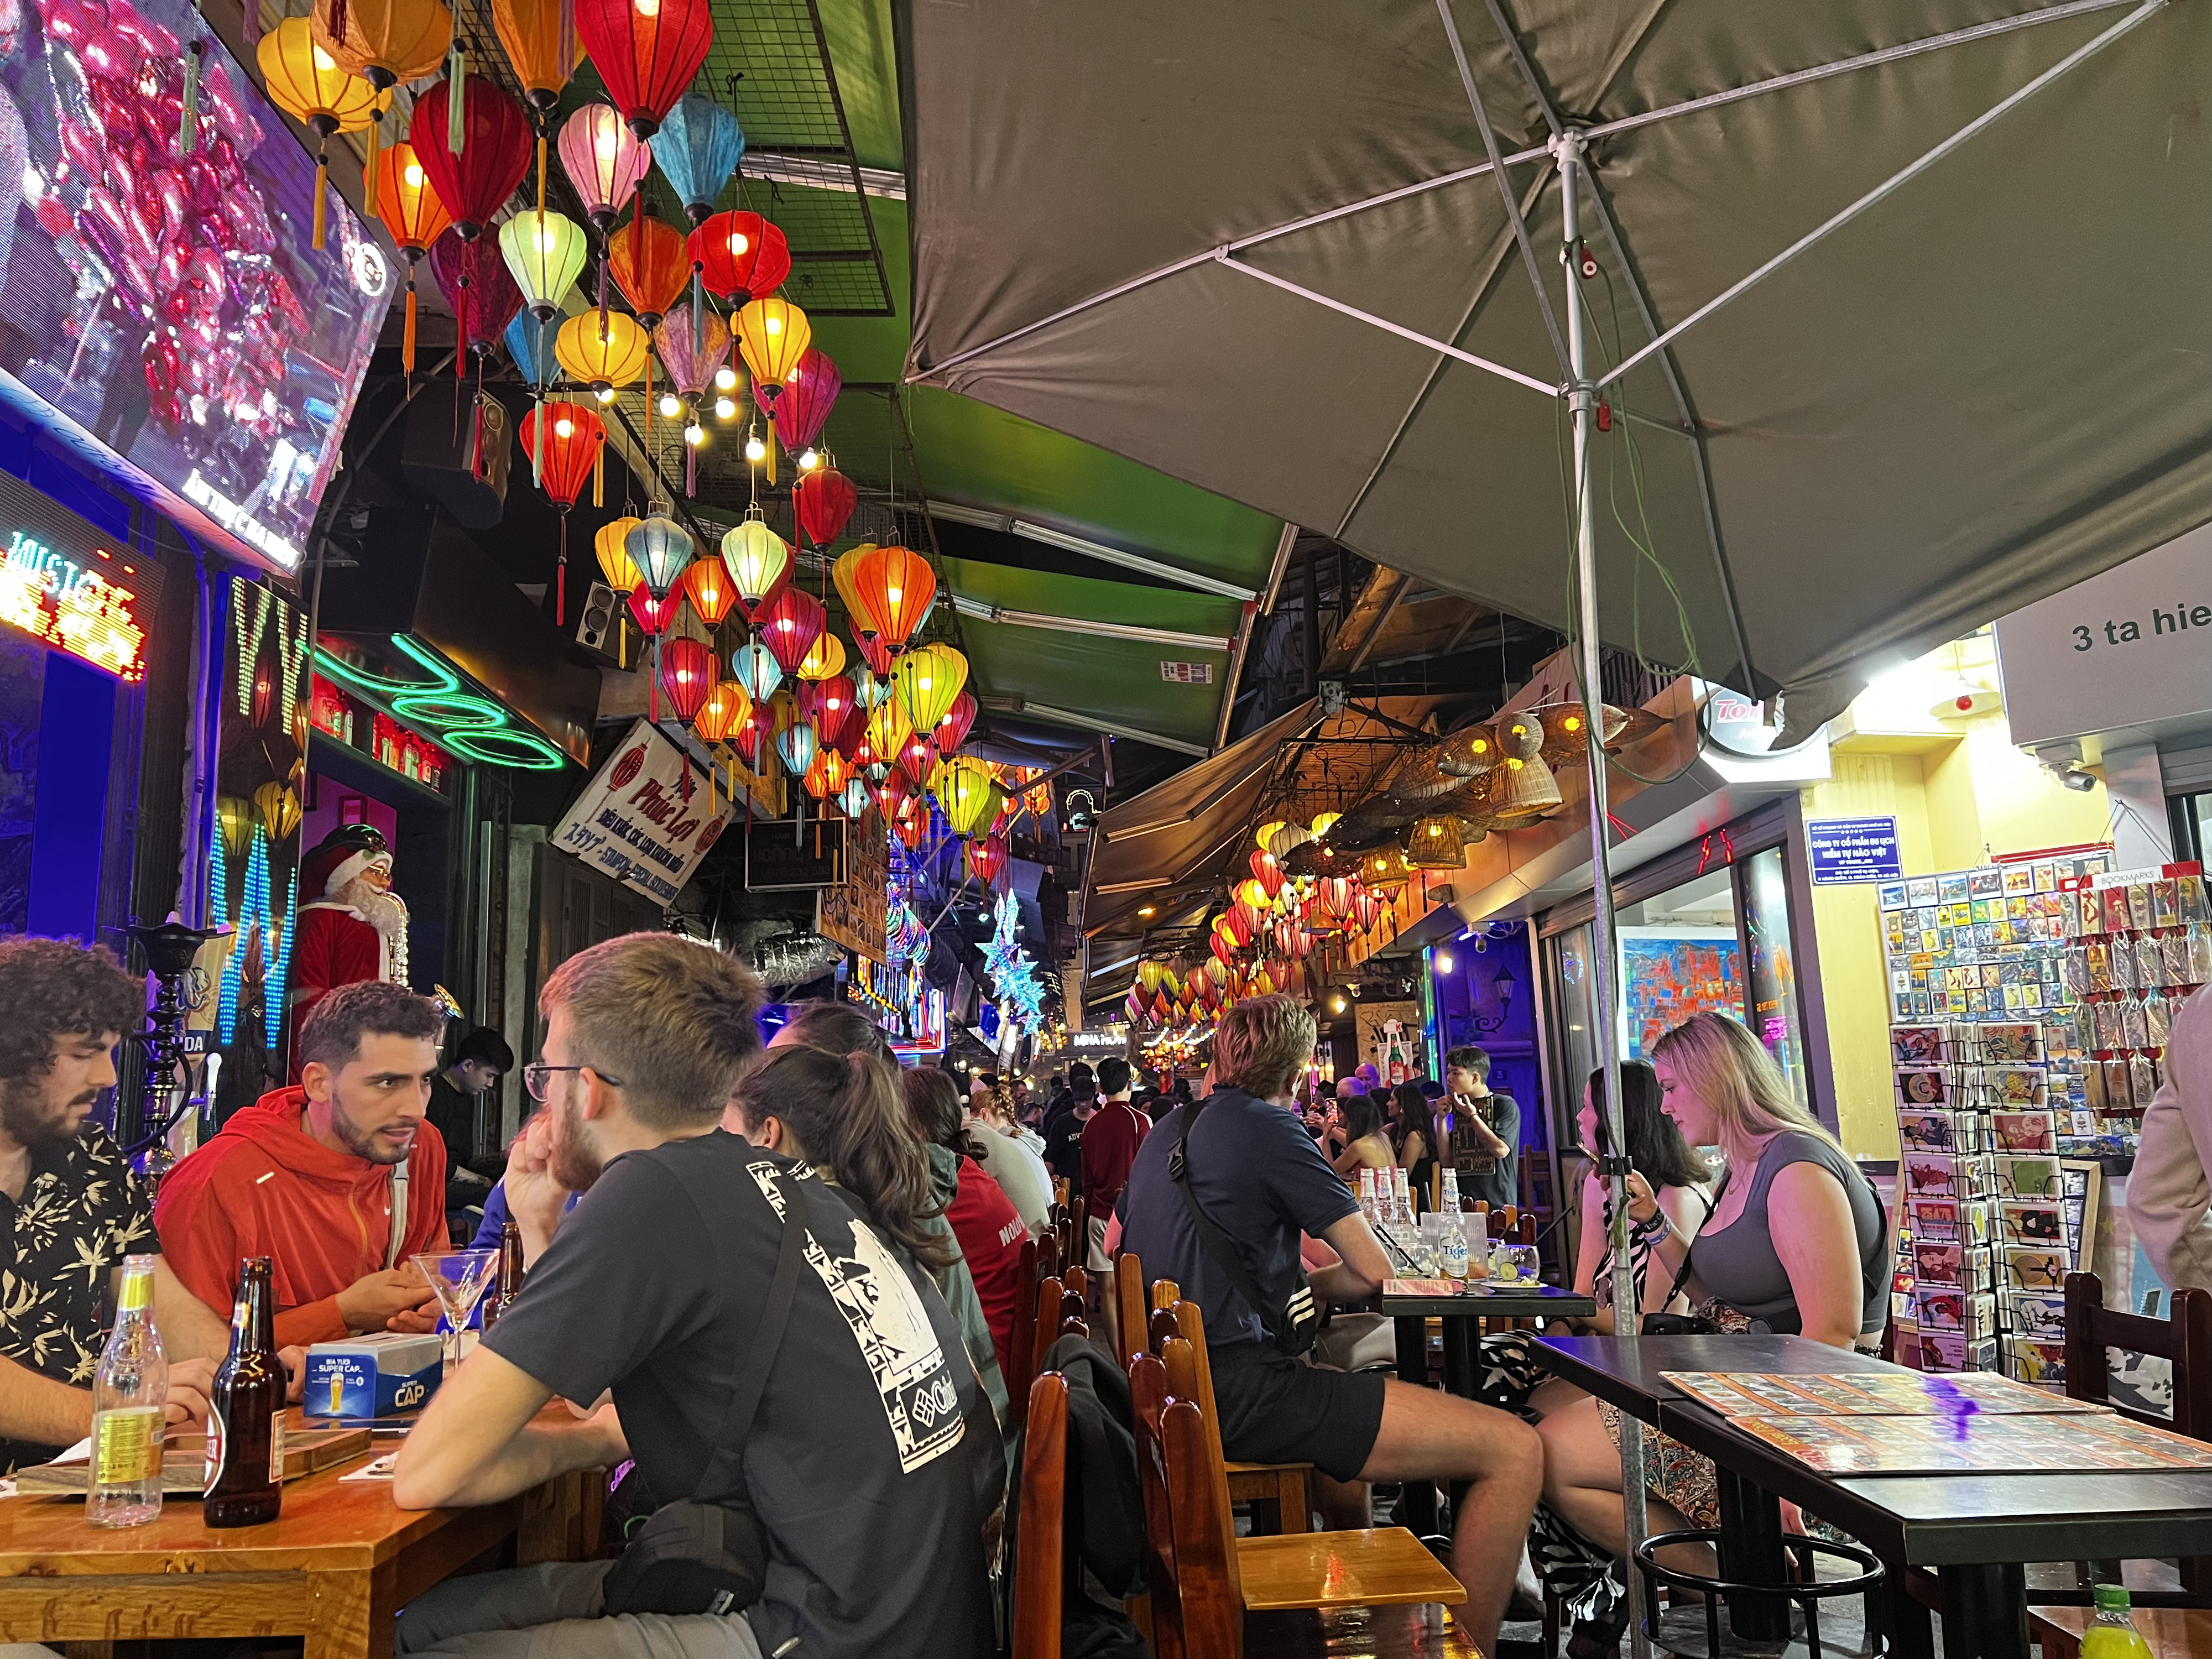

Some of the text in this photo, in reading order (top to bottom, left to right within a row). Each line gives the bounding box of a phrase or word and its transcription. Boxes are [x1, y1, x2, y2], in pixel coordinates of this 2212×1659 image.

[2072, 603, 2212, 652] 3 ta hie
[628, 778, 676, 825] Phúc
[664, 806, 701, 843] Lợi
[2101, 871, 2154, 884] BOOKMARKS
[395, 1385, 425, 1407] CAP
